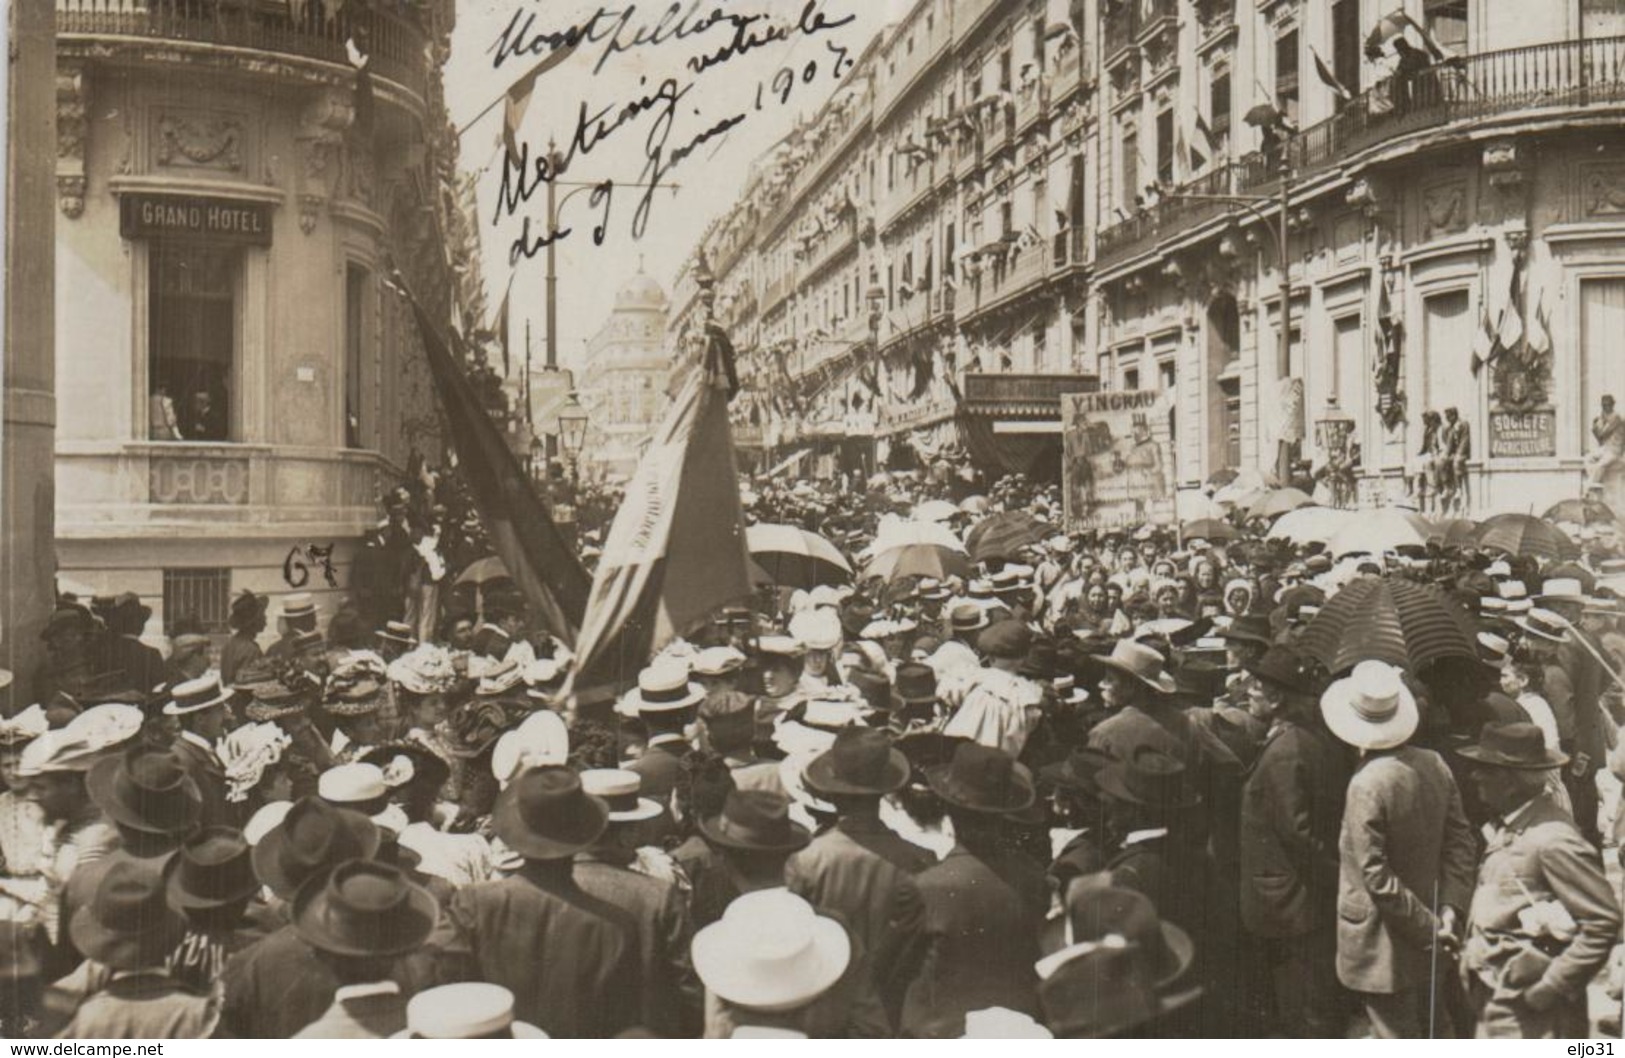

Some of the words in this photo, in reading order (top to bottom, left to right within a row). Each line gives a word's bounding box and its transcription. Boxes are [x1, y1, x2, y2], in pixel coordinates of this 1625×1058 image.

[143, 202, 200, 227] GRAND
[208, 206, 261, 232] HOTEL
[510, 216, 572, 267] du
[589, 178, 613, 246] 9
